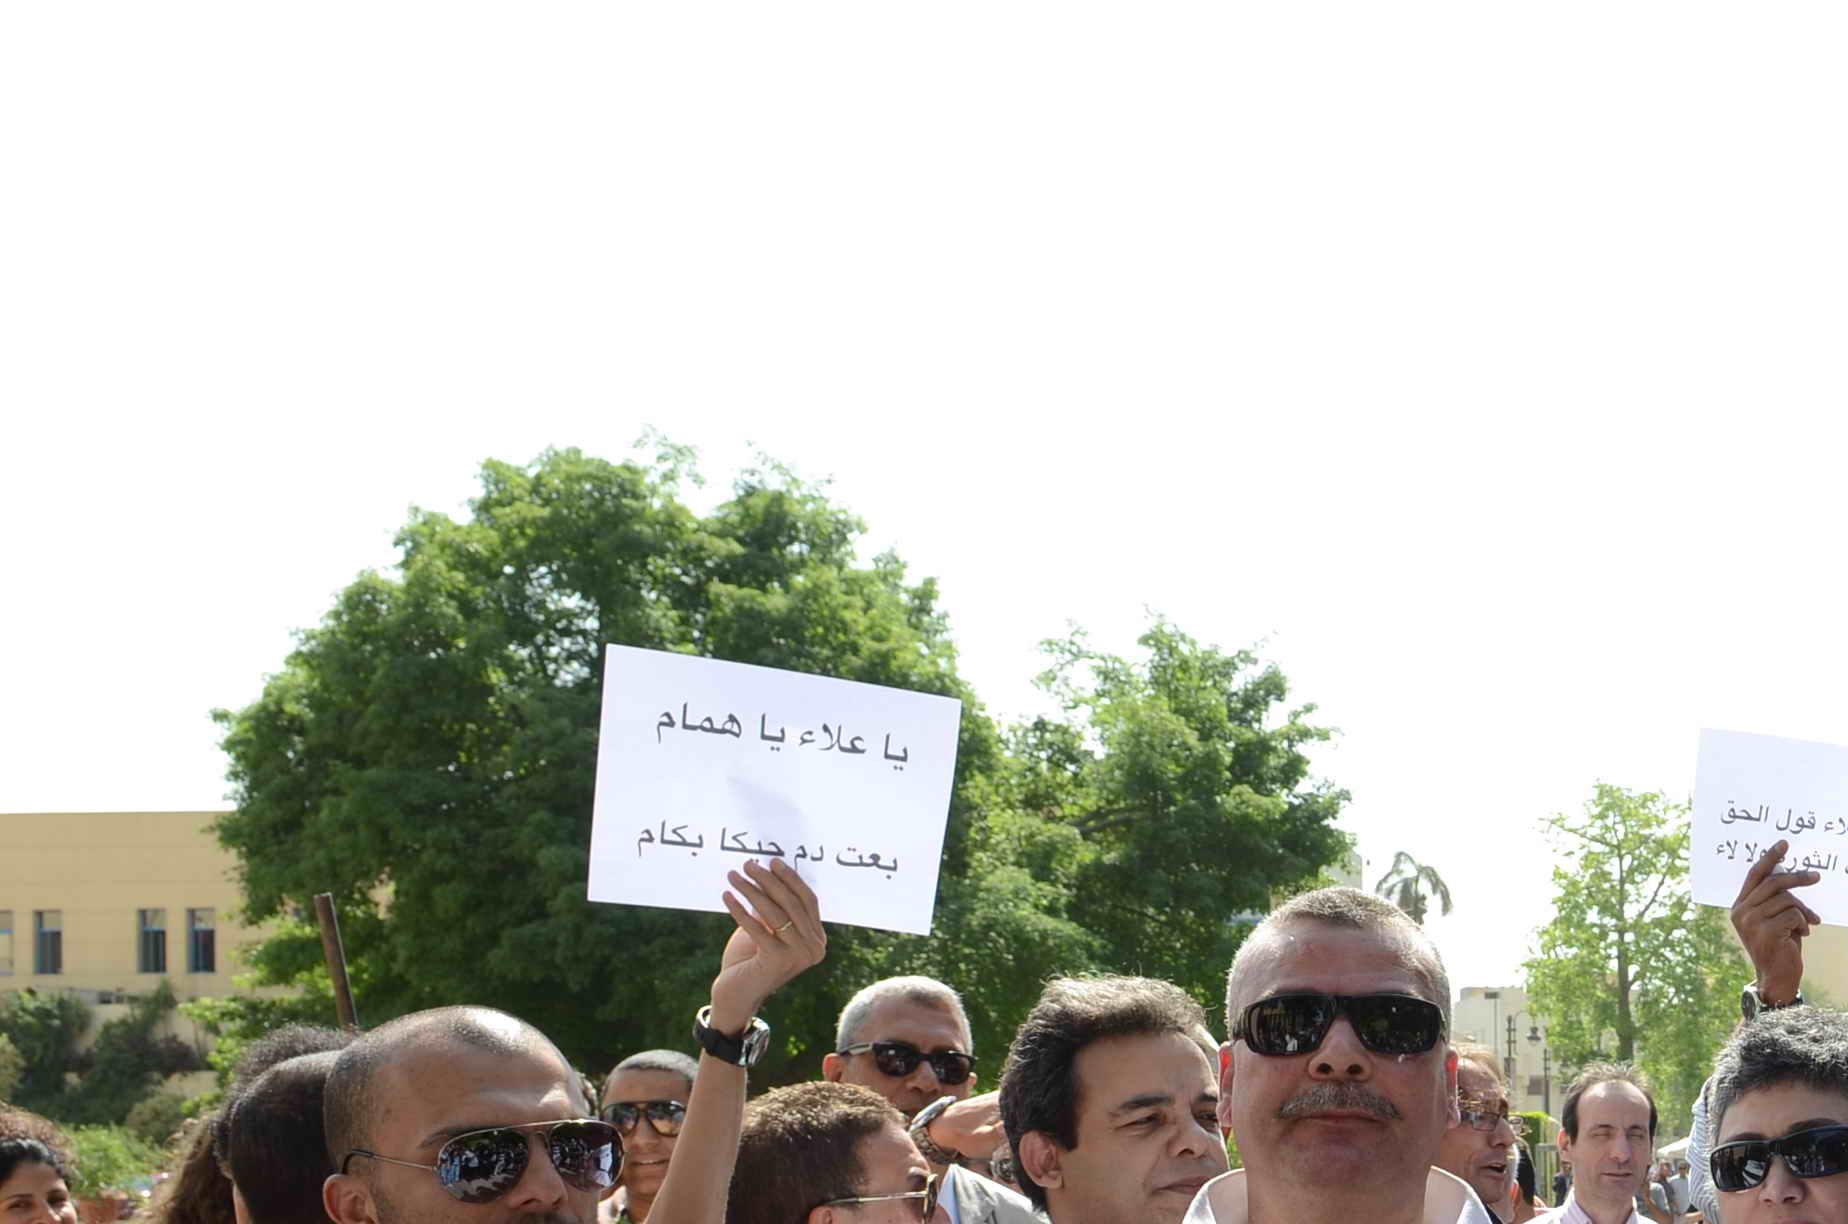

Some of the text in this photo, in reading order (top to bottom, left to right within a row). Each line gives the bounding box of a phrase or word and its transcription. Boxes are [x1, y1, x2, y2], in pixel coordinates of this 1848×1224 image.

[656, 703, 909, 771] يا علاء يا همام
[1721, 801, 1769, 824] الحق
[1776, 809, 1816, 834] قول
[637, 820, 703, 858] بكام
[794, 845, 824, 868] دم
[836, 845, 898, 880] بعت
